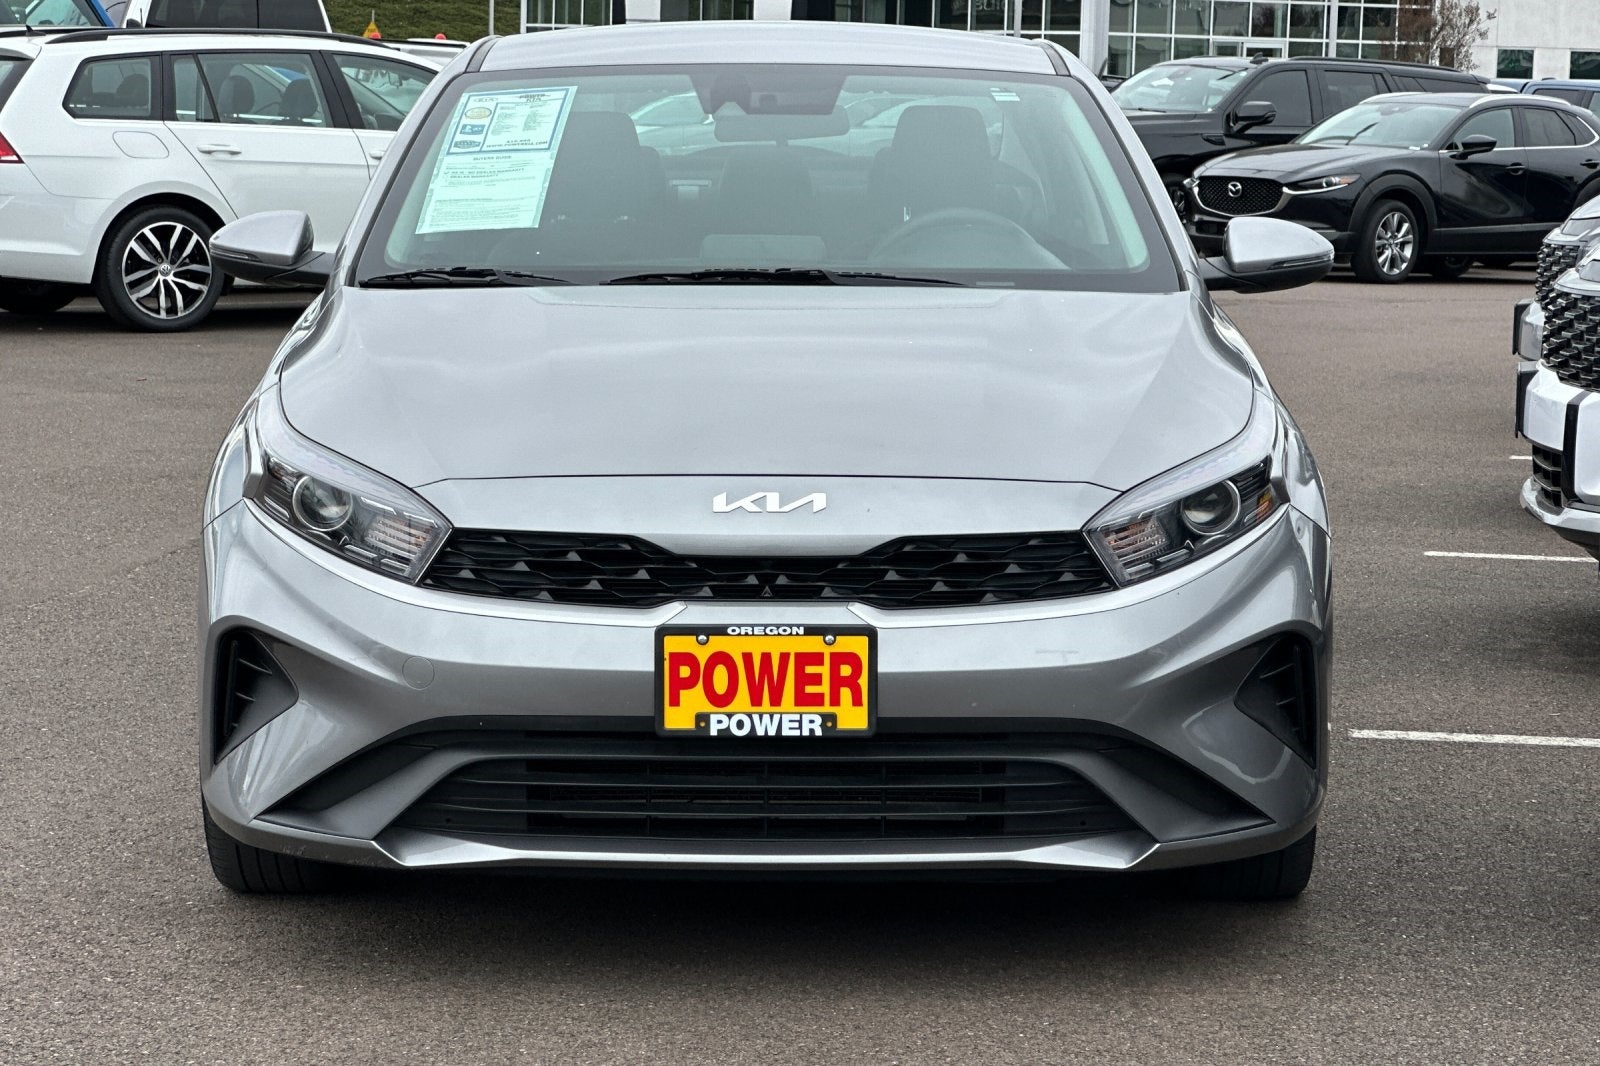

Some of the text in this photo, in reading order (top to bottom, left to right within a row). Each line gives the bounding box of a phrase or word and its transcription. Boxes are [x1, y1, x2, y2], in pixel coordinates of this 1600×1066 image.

[713, 491, 827, 513] KIA
[727, 626, 804, 636] OREGON
[668, 651, 863, 708] POWER
[709, 714, 822, 736] POWER
